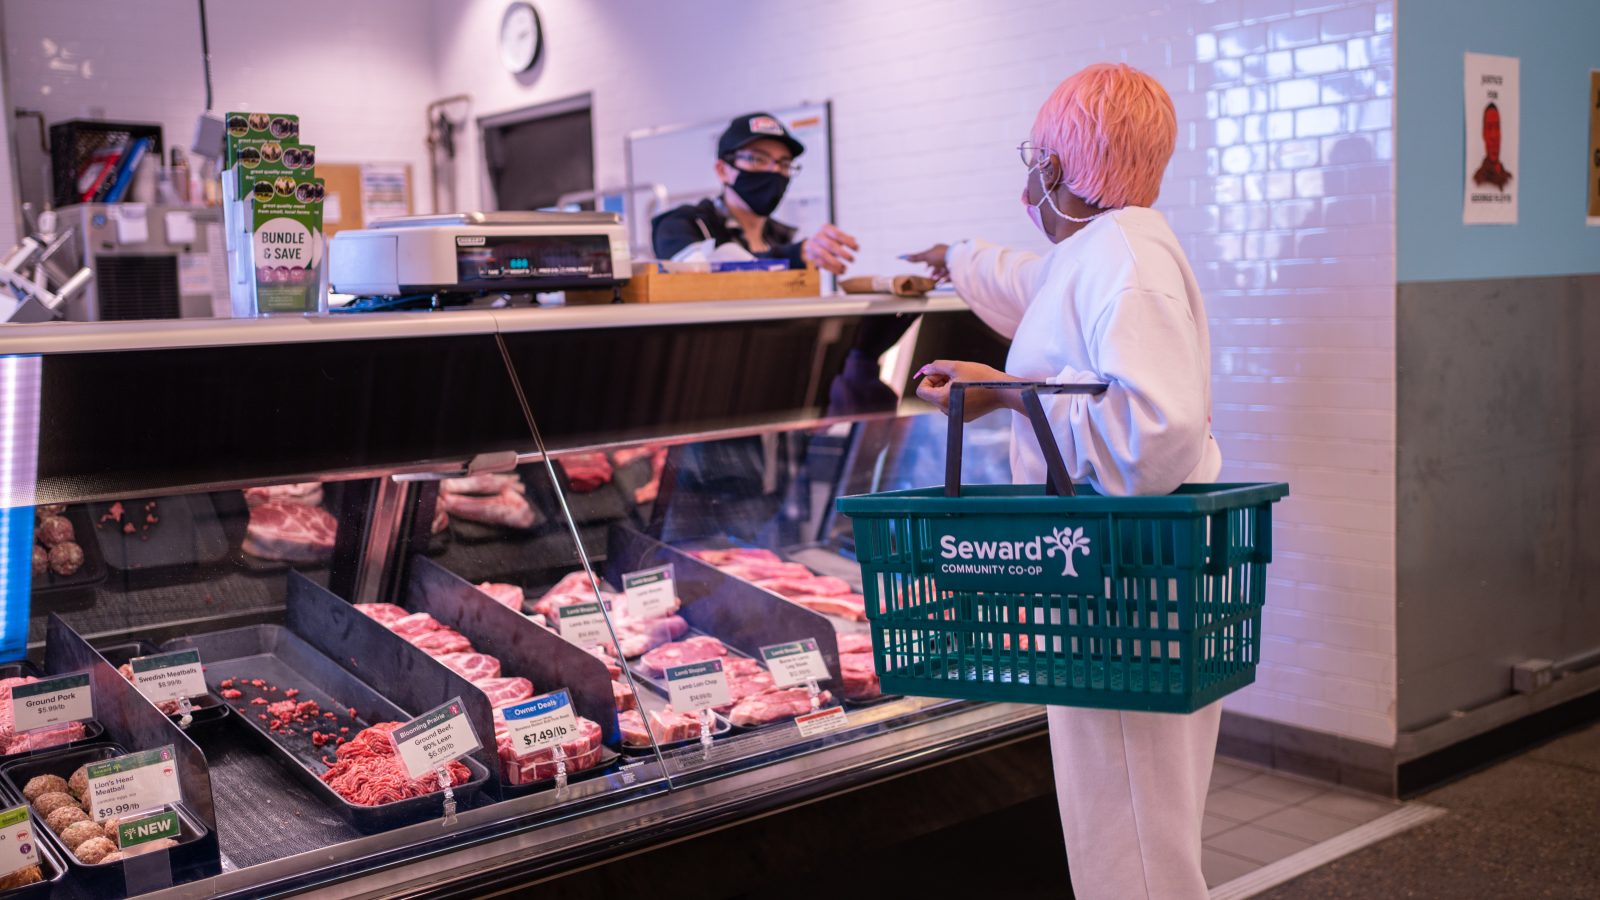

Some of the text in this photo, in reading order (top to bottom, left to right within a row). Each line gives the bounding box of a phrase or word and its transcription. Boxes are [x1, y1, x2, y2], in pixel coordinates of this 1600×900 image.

[262, 232, 304, 244] BUNDLE
[263, 248, 302, 260] & SAVE
[940, 535, 1042, 560] Seward
[941, 563, 1043, 576] COMMUNITY CO-OP
[138, 668, 197, 683] Swedish Meatballs
[158, 679, 182, 688] $8.99/lb
[26, 692, 76, 707] Ground Pork
[37, 704, 66, 714] $5.99/lb
[514, 699, 557, 716] Owner Deals
[399, 713, 446, 739] Blooming Prairie
[414, 723, 454, 746] Ground Beef,
[523, 725, 567, 745] $7.49/lb
[422, 734, 452, 752] 80% Lean
[428, 743, 455, 759] $6.99/lb
[94, 775, 134, 789] Lion's Head
[95, 784, 126, 796] Meatball
[98, 802, 140, 818] $9.99/lb
[137, 819, 171, 837] NEW
